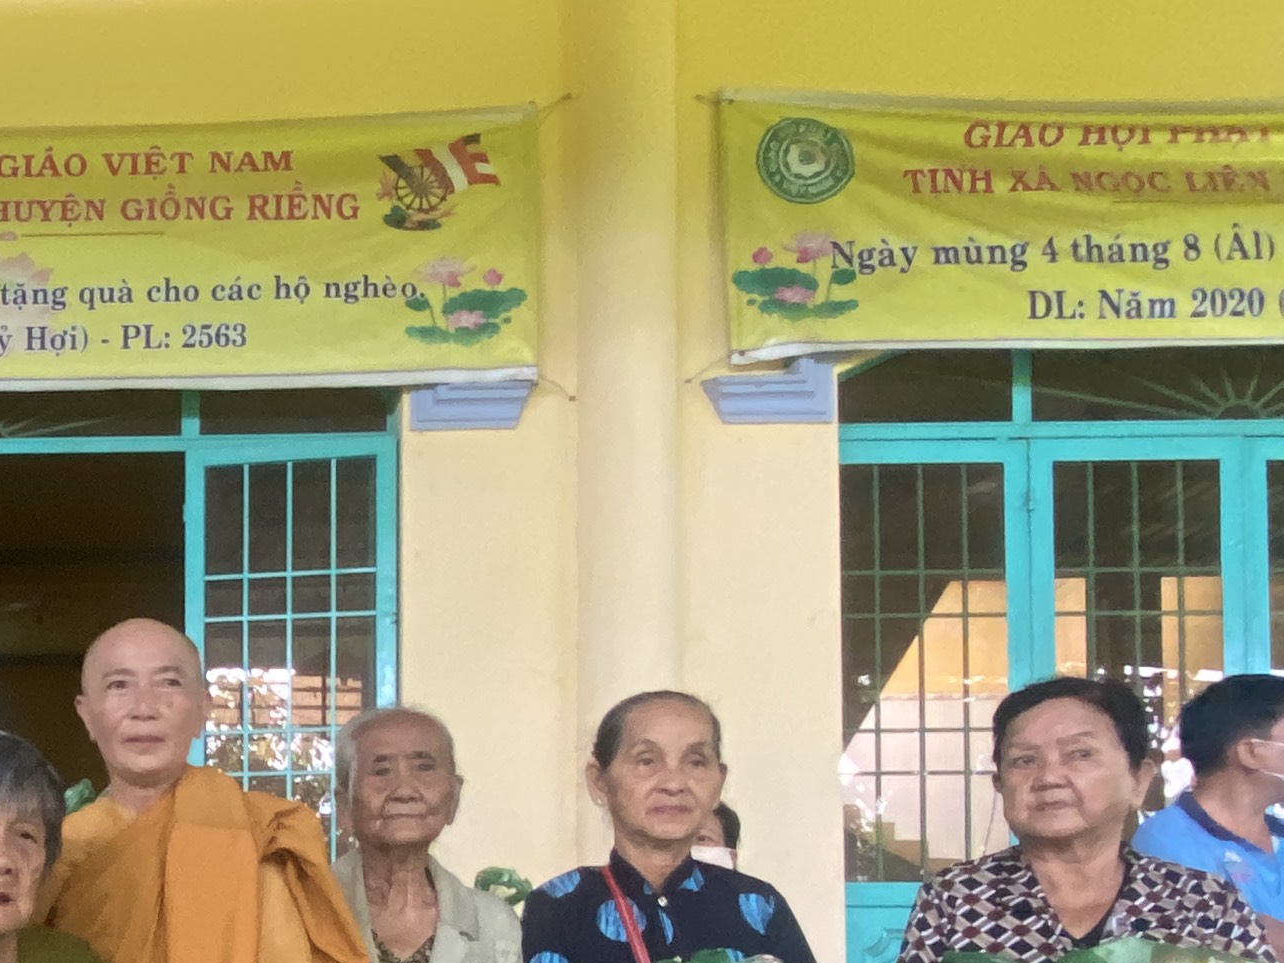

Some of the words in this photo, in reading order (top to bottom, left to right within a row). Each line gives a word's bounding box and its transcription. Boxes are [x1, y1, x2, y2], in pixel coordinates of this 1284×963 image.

[102, 145, 194, 180] VIỆT
[209, 150, 294, 173] NAM
[120, 183, 234, 221] GIỒNG
[246, 179, 360, 221] RIỀNG
[829, 240, 918, 274] Ngày
[1041, 236, 1059, 261] 4
[1070, 234, 1171, 269] tháng
[1183, 234, 1201, 261] 8
[1, 282, 68, 310] tặng
[79, 279, 134, 311] quà
[146, 277, 200, 303] cho
[211, 277, 262, 302] các
[274, 275, 311, 302] hộ
[323, 274, 426, 301] nghèo.
[1028, 290, 1087, 320] DL:
[1098, 290, 1177, 320] Năm
[1190, 288, 1265, 318] 2020
[25, 326, 88, 355] Hợi)
[121, 325, 171, 350] PL:
[182, 323, 247, 348] 2563
